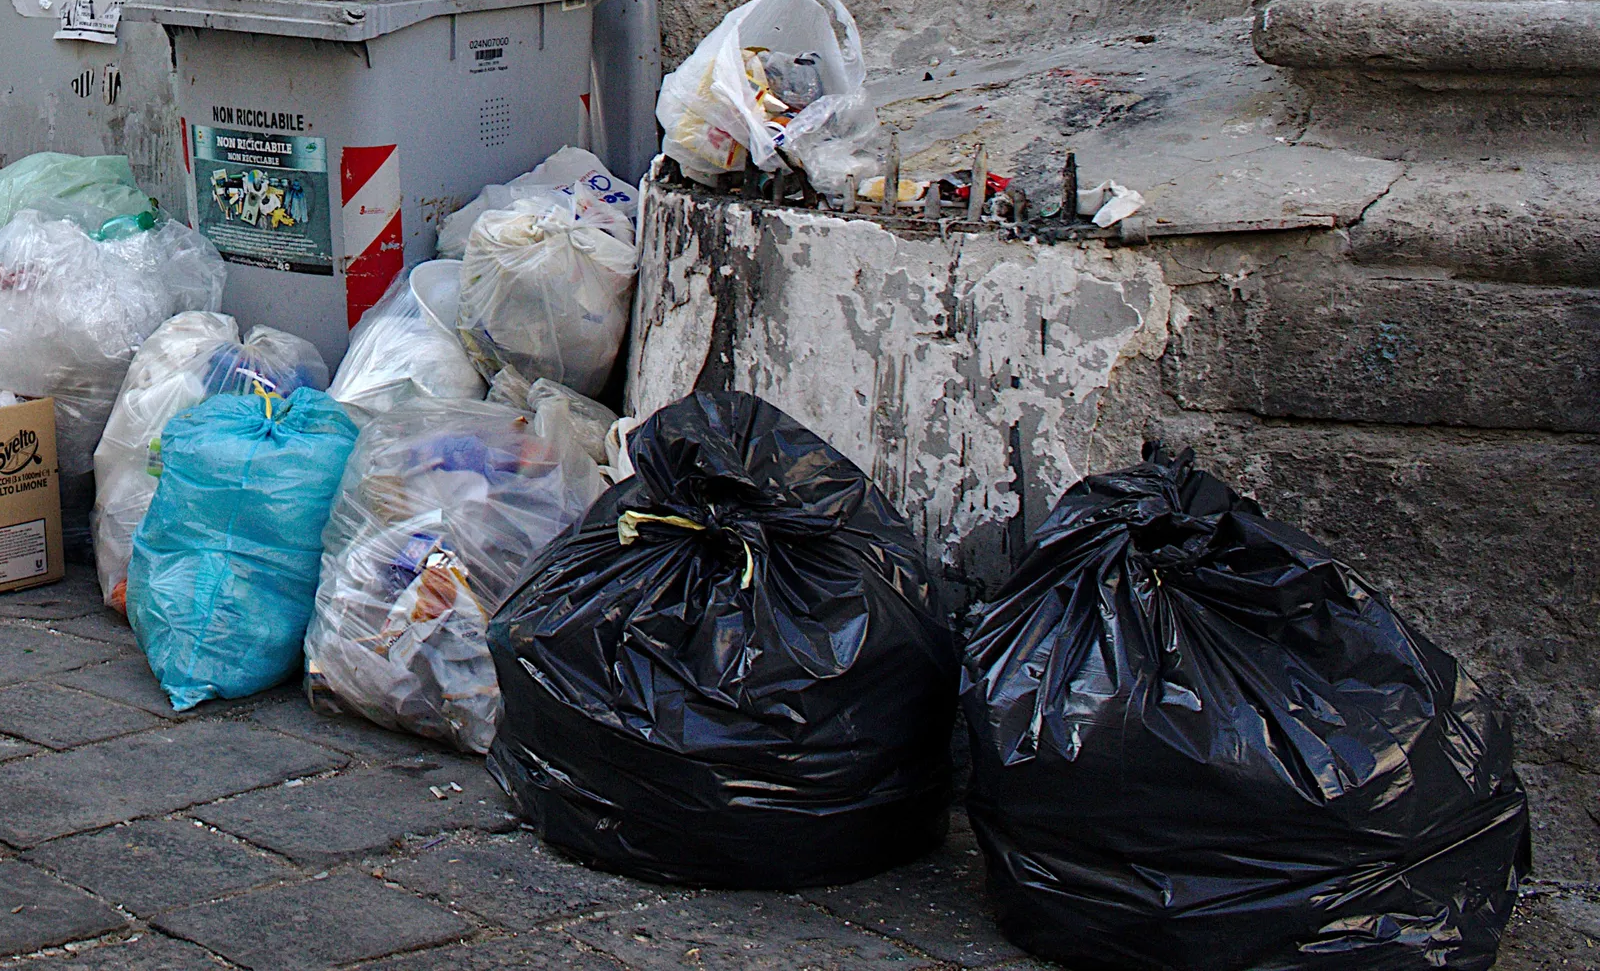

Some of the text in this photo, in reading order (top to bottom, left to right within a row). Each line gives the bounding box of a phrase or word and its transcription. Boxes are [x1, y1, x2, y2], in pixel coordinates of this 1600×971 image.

[213, 106, 304, 131] NON RICICLABILE
[216, 136, 292, 154] NON RICICLABILE
[228, 152, 280, 166] NON RECYCLABLE
[22, 470, 41, 481] 1000ml
[16, 479, 47, 493] LIMONE
